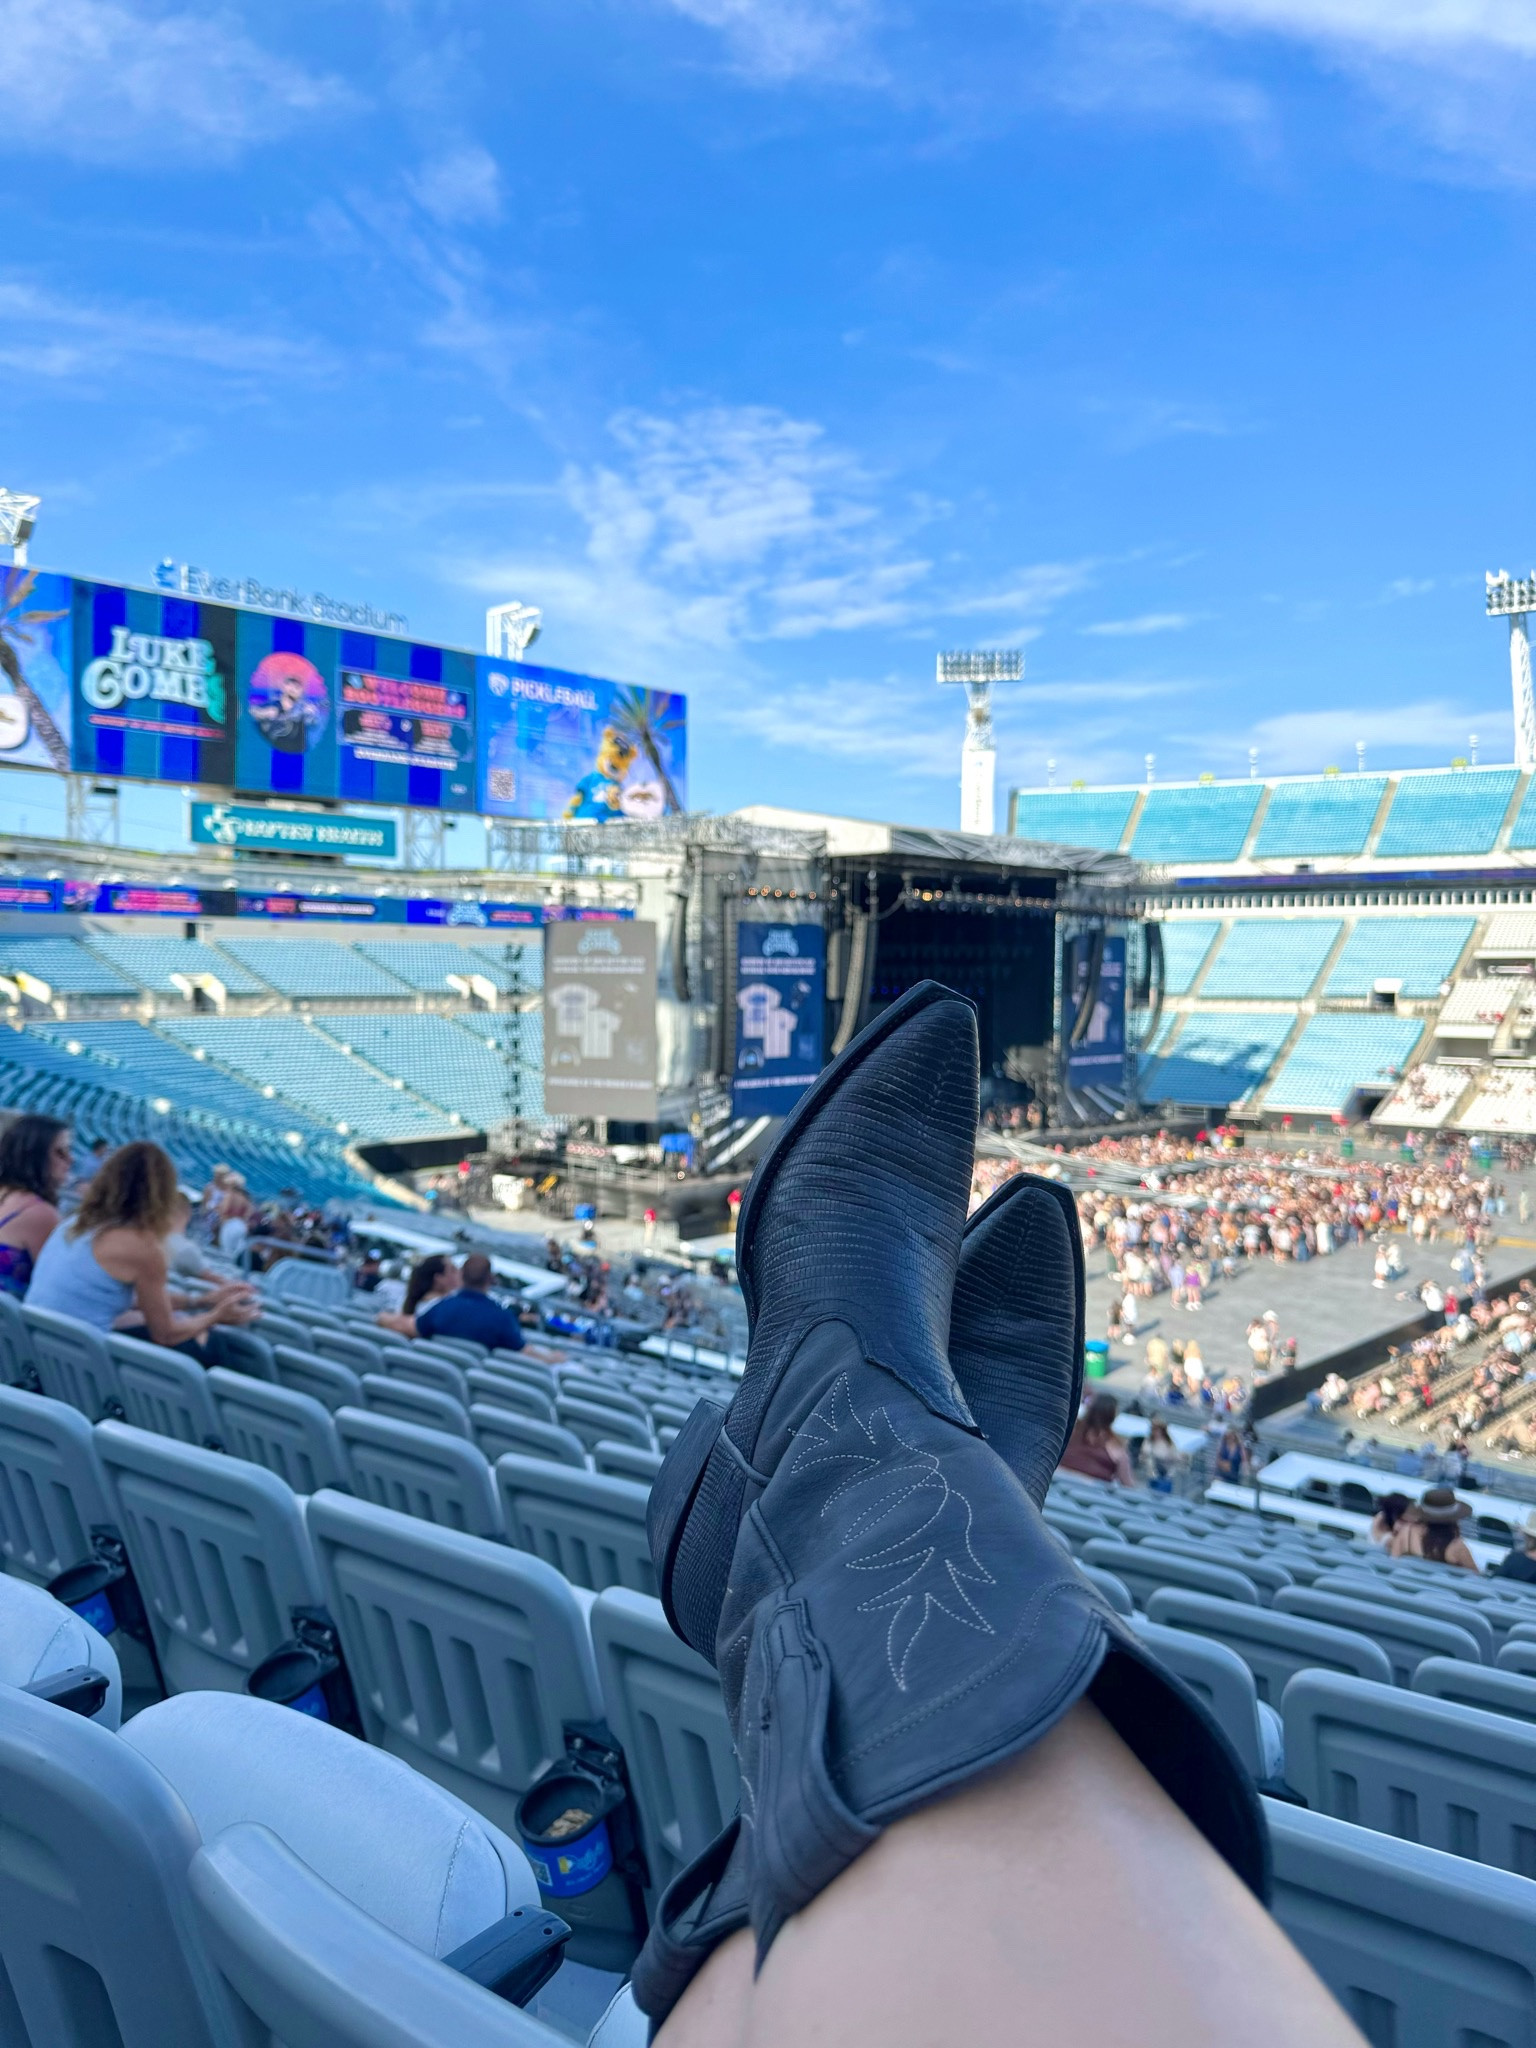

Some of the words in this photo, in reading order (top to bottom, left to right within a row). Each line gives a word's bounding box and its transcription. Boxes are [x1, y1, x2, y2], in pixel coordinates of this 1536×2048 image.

[180, 563, 307, 613] EverBank
[309, 590, 408, 632] Stadium
[109, 625, 217, 675] LUKE
